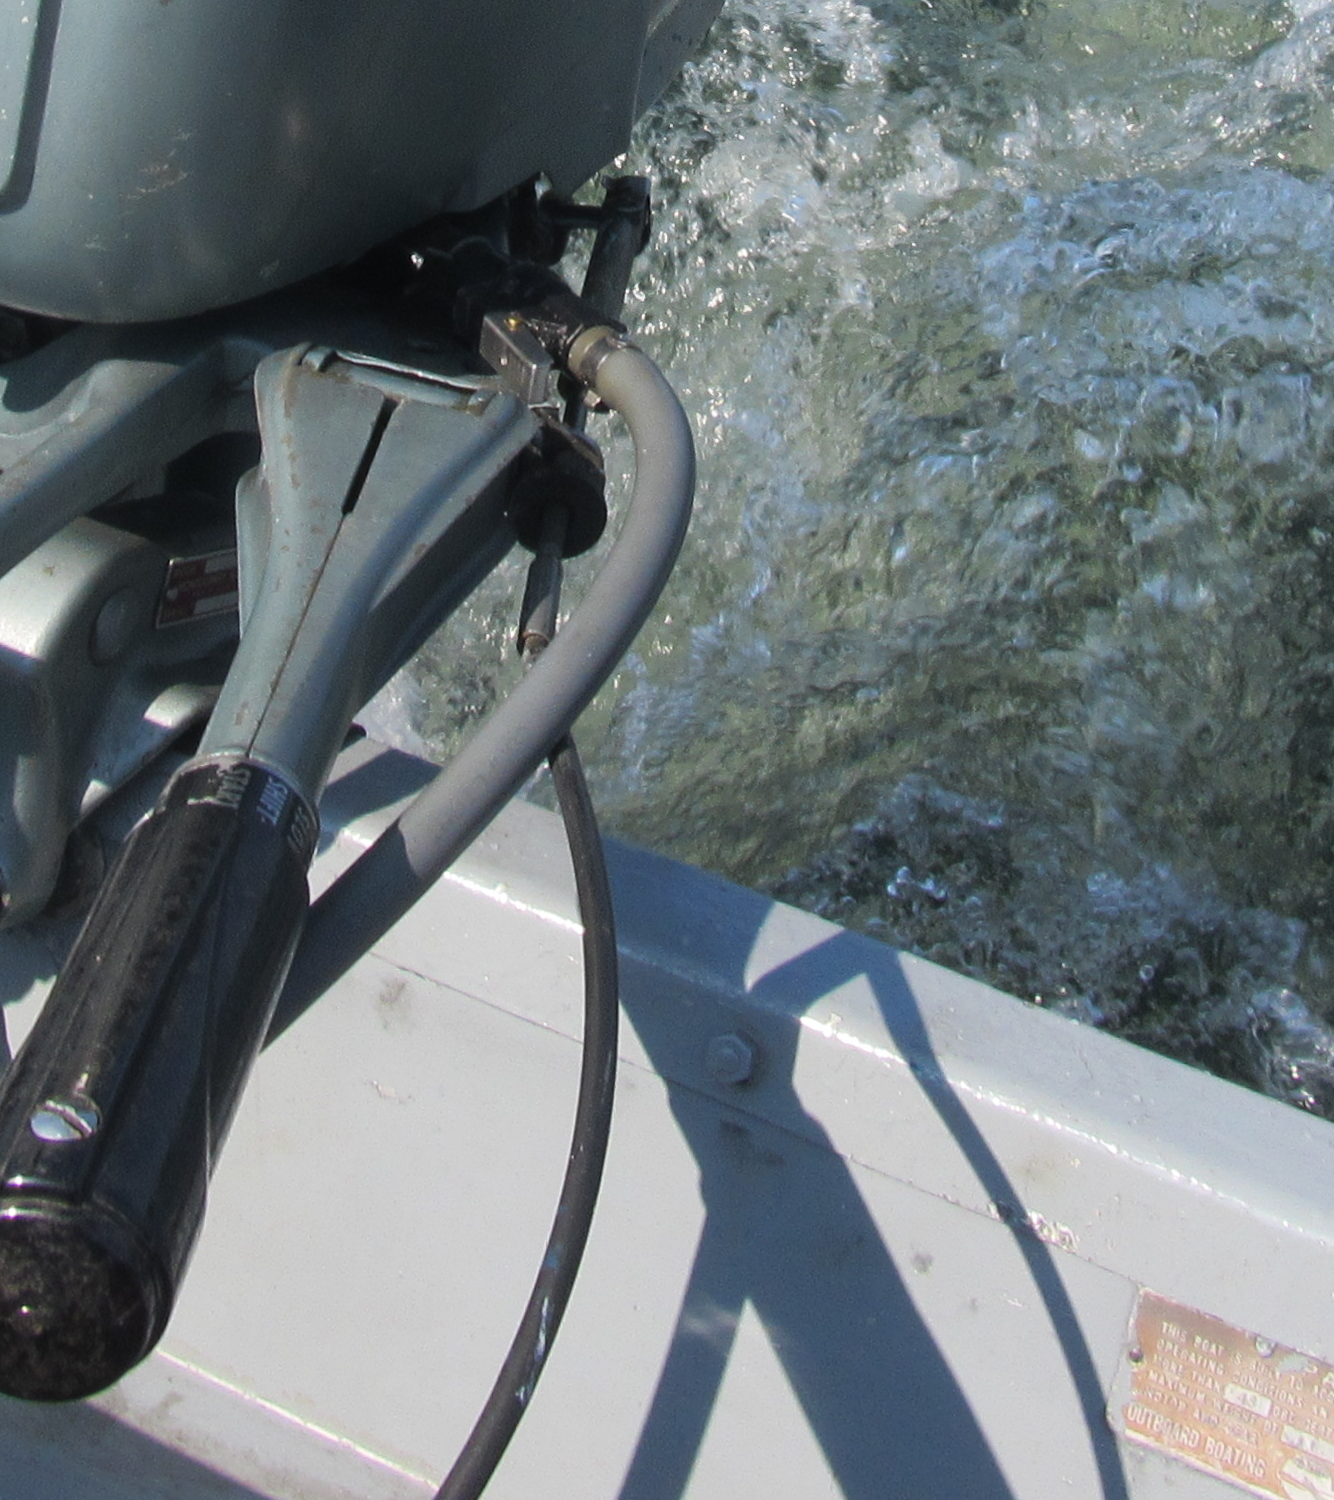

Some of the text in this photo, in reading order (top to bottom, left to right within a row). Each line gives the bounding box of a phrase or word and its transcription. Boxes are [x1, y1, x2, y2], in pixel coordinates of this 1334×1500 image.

[1155, 1338, 1226, 1376] OPERATING
[1161, 1320, 1188, 1343] THIS
[1192, 1334, 1226, 1357] BOAT
[1127, 1402, 1200, 1448] OUTBOARD
[1204, 1436, 1267, 1479] BOATING
